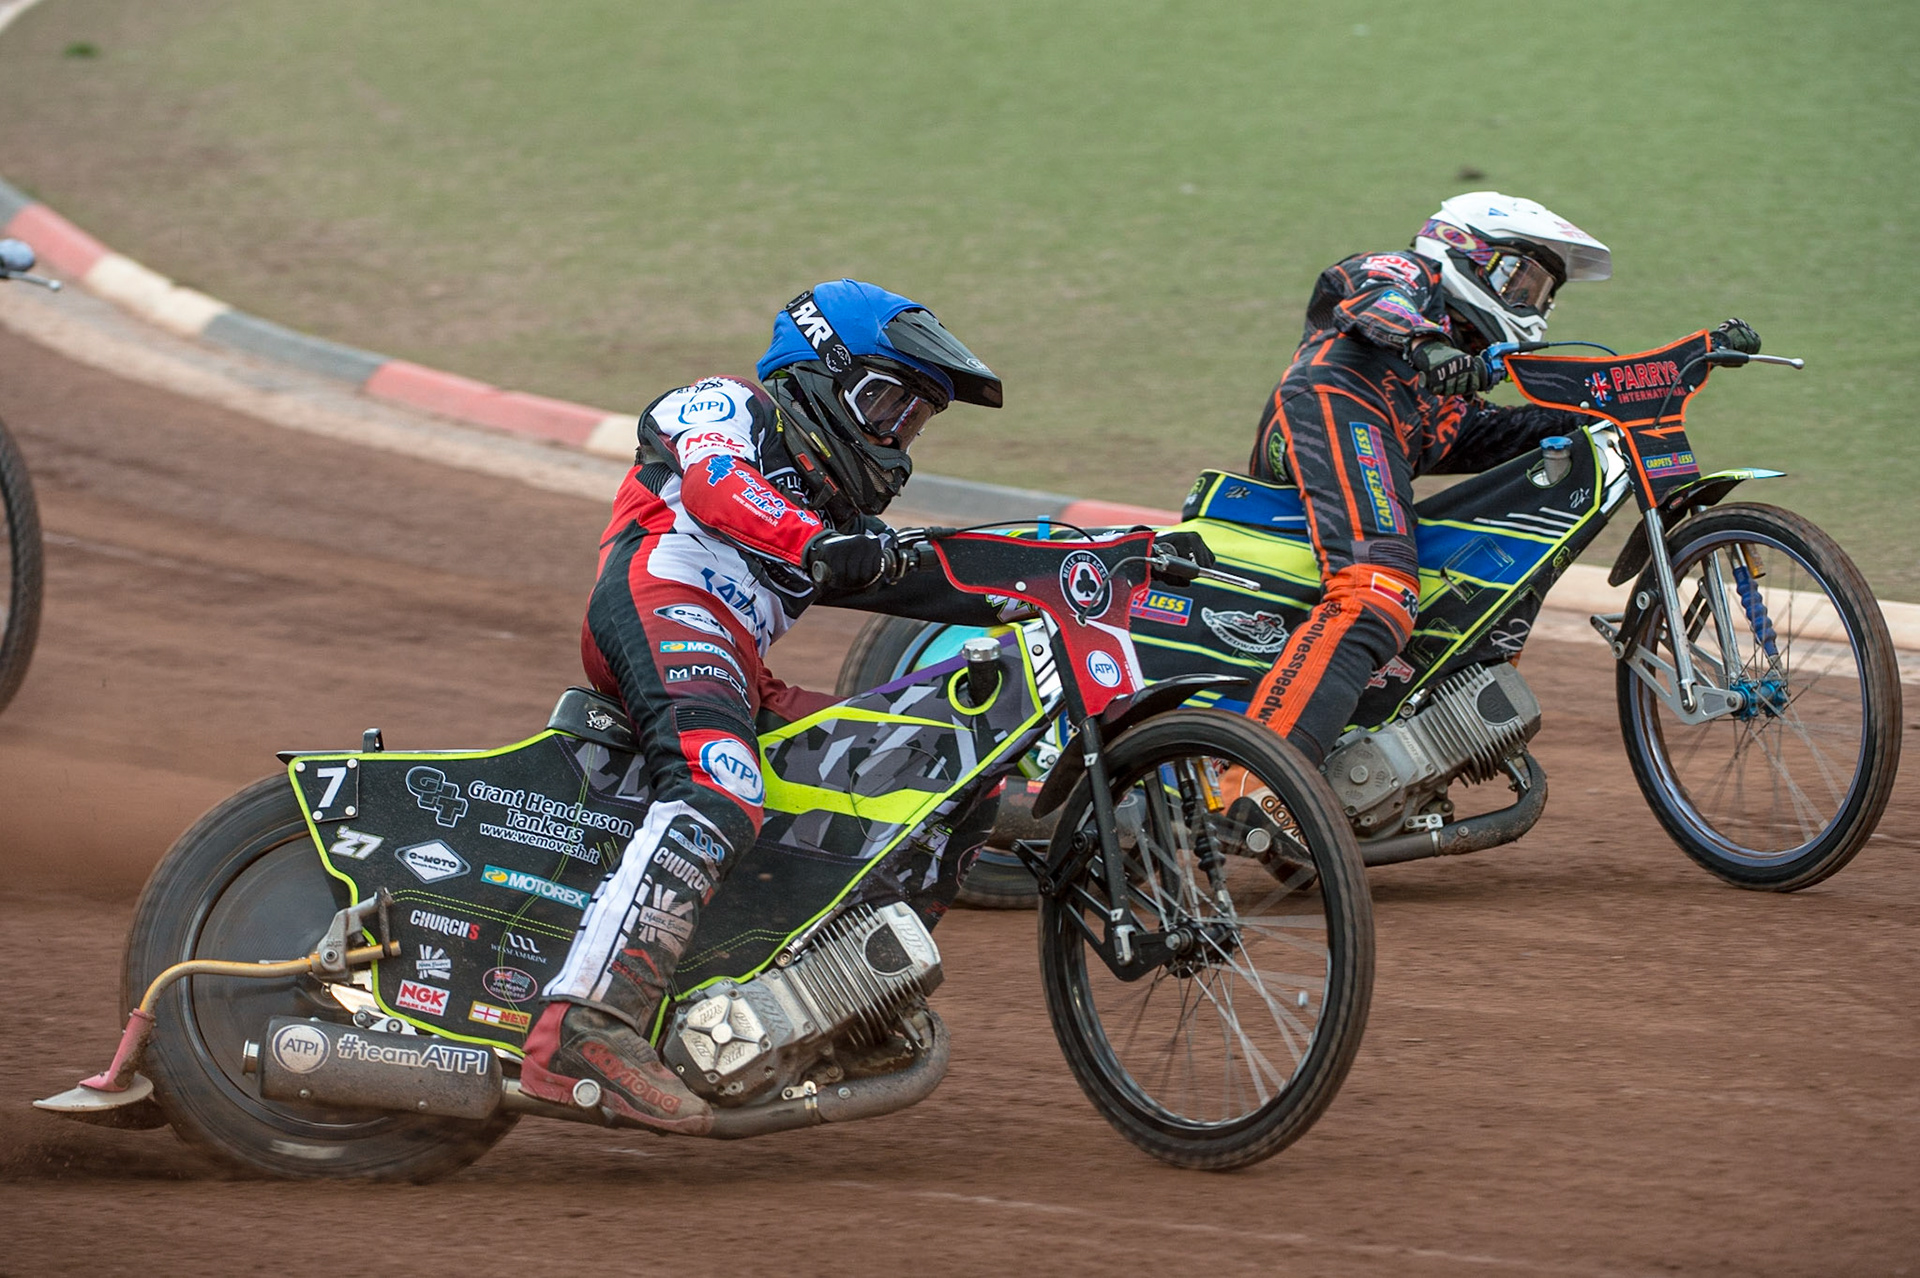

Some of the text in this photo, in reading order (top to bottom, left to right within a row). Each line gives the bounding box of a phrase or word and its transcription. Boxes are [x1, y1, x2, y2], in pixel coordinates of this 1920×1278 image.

[1437, 354, 1472, 381] UNIT
[1610, 360, 1682, 392] PARRYS
[687, 400, 725, 416] ATPI
[1354, 427, 1374, 456] LESS
[1357, 455, 1377, 469] 4
[1645, 457, 1673, 469] CARPETS
[1679, 453, 1694, 465] LESS
[741, 487, 784, 519] Tankers
[1062, 554, 1107, 579] BELLE VUE ACES
[1134, 588, 1186, 613] 4 LESS
[1094, 663, 1116, 677] ATPI
[714, 752, 759, 790] ATPI
[317, 766, 348, 809] 7
[468, 780, 635, 839] Grant Henderson
[506, 808, 586, 844] Tankers
[329, 825, 385, 861] 27
[479, 822, 601, 865] www.wemovesh.it
[508, 872, 586, 907] MOTOREX
[398, 1000, 441, 1015] SPARK PLUGS
[400, 983, 446, 1007] NGK
[283, 1037, 319, 1056] ATPI
[337, 1034, 489, 1075] #teamATPI
[581, 1041, 683, 1114] daytona
